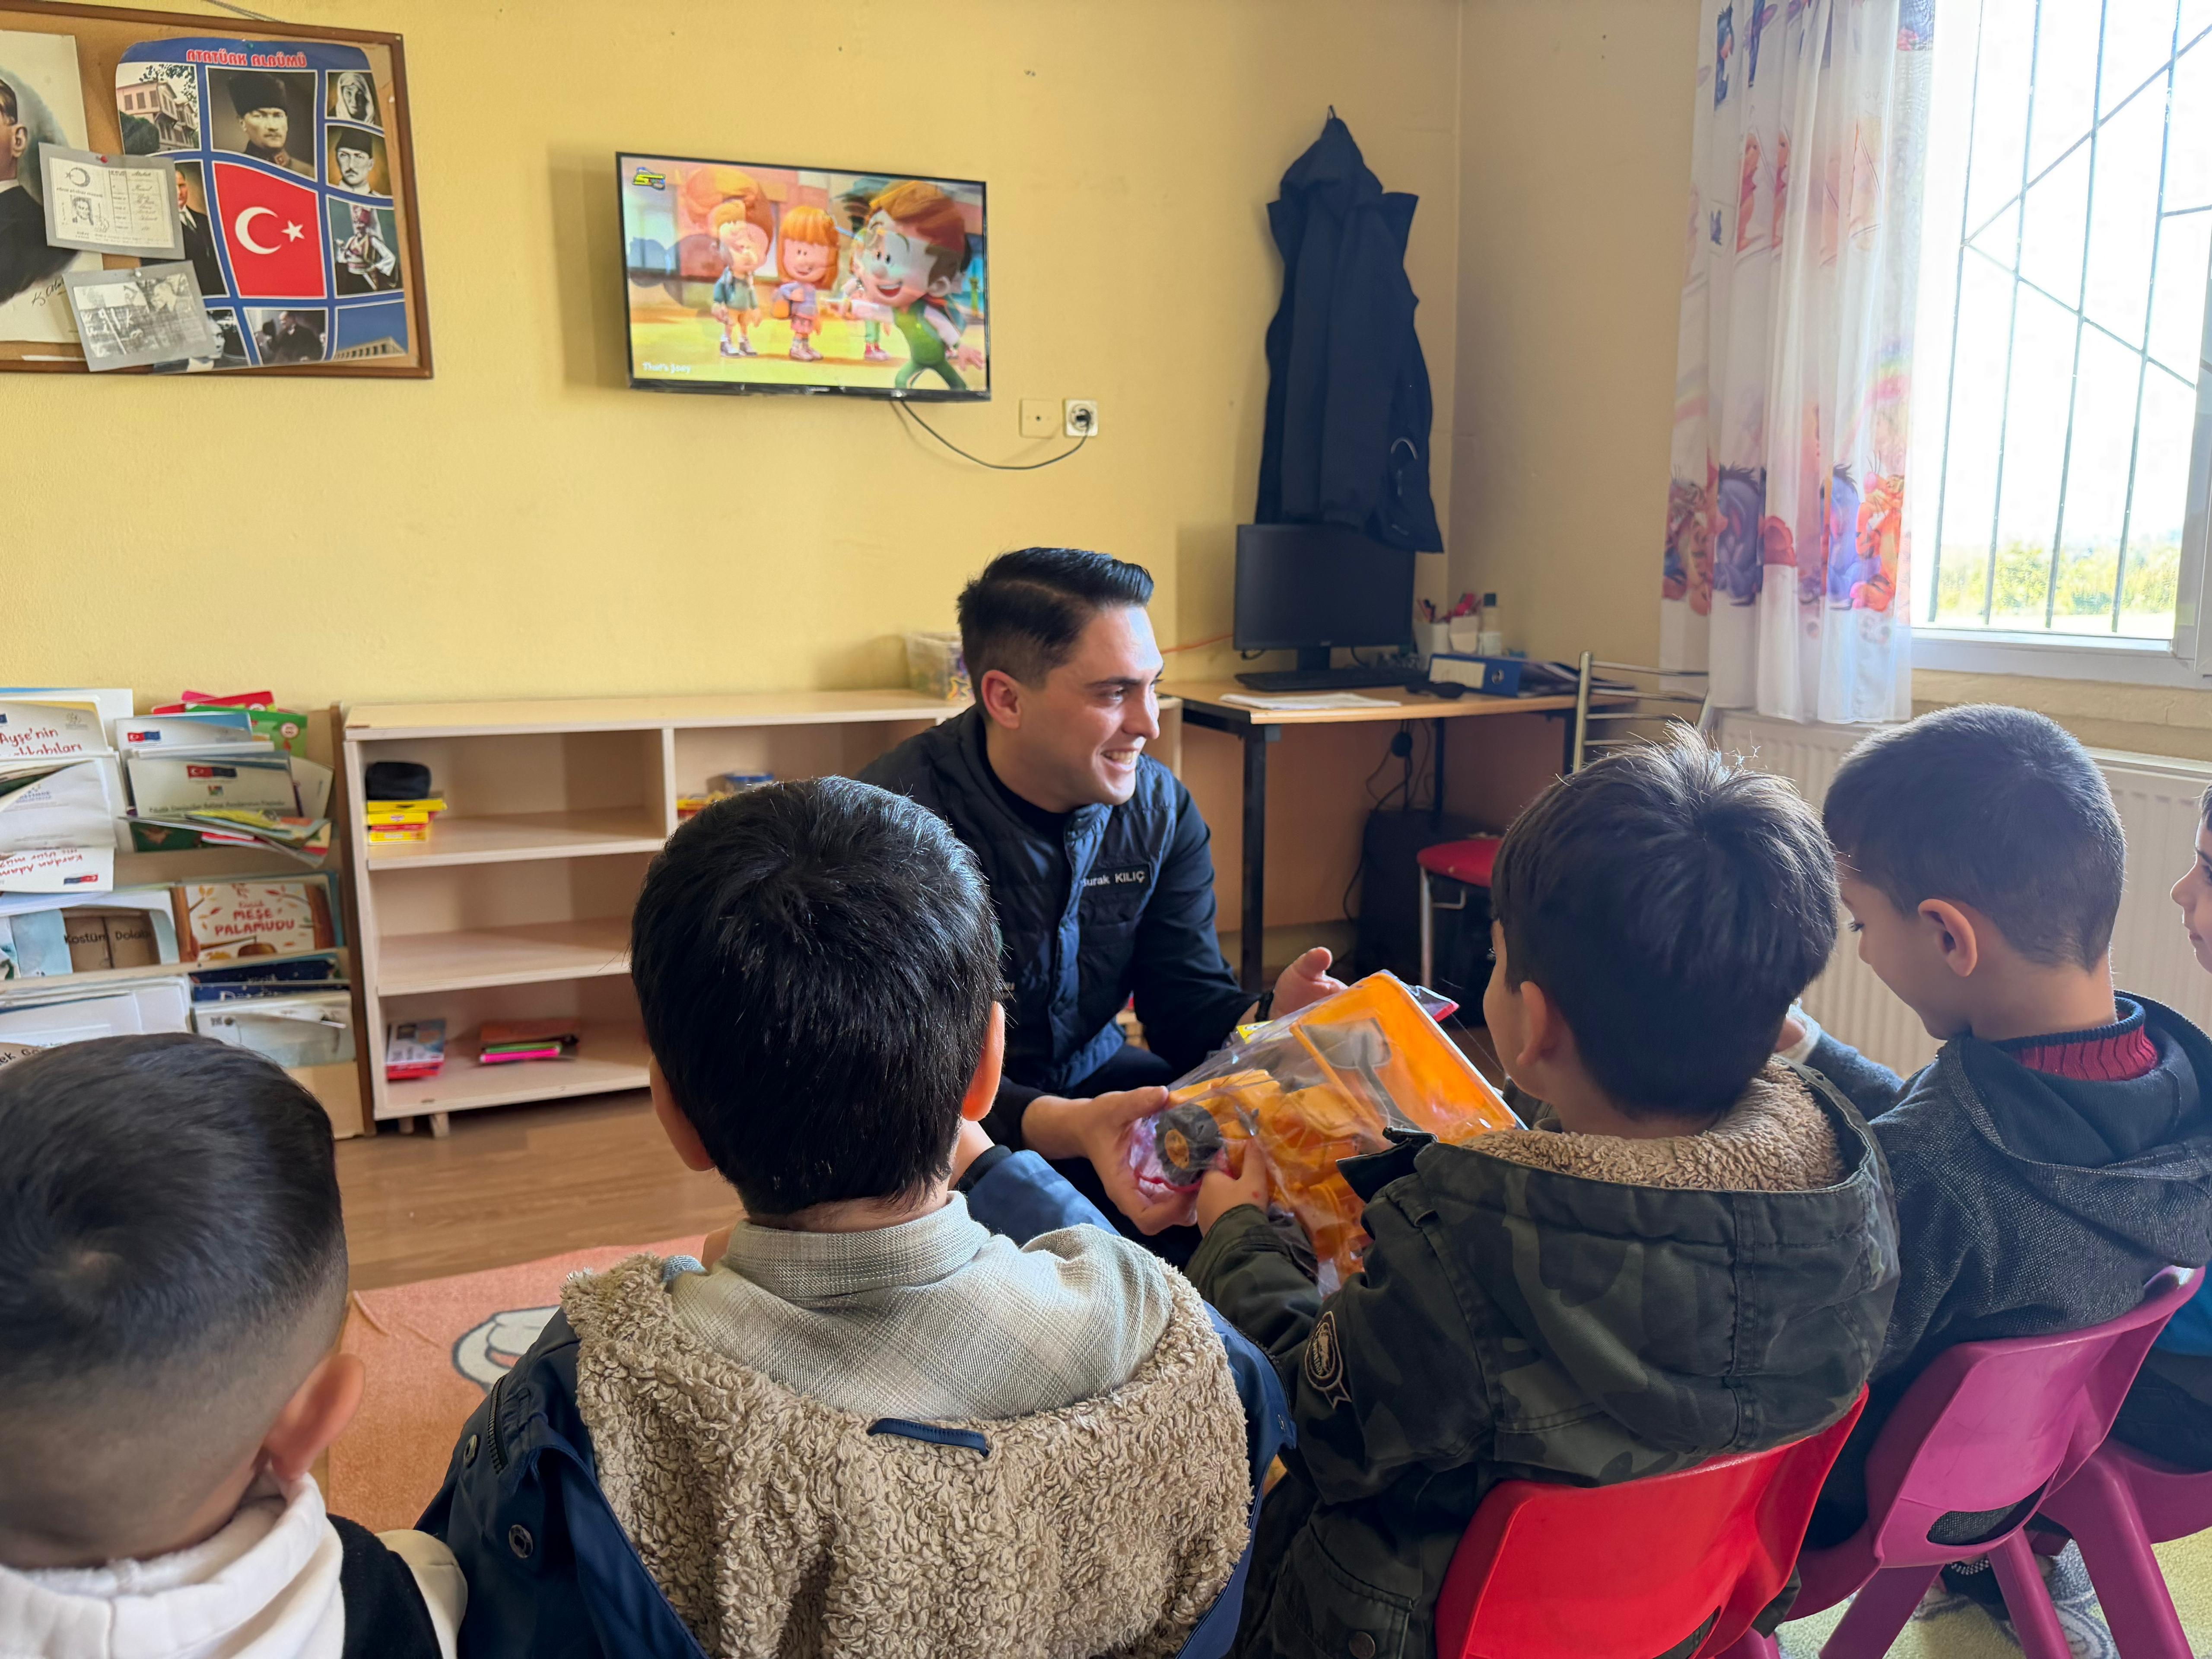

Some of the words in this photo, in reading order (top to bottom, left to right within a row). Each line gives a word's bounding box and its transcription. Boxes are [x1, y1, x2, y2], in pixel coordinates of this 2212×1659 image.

[186, 48, 248, 66] ATATÜRK
[251, 51, 307, 68] ALBÜMÜ
[0, 728, 59, 747] Ayşe'nin
[1115, 871, 1146, 884] KILIÇ
[232, 908, 273, 920] MEŞE
[214, 919, 295, 936] PALAMUDU
[64, 932, 109, 944] Kostüm
